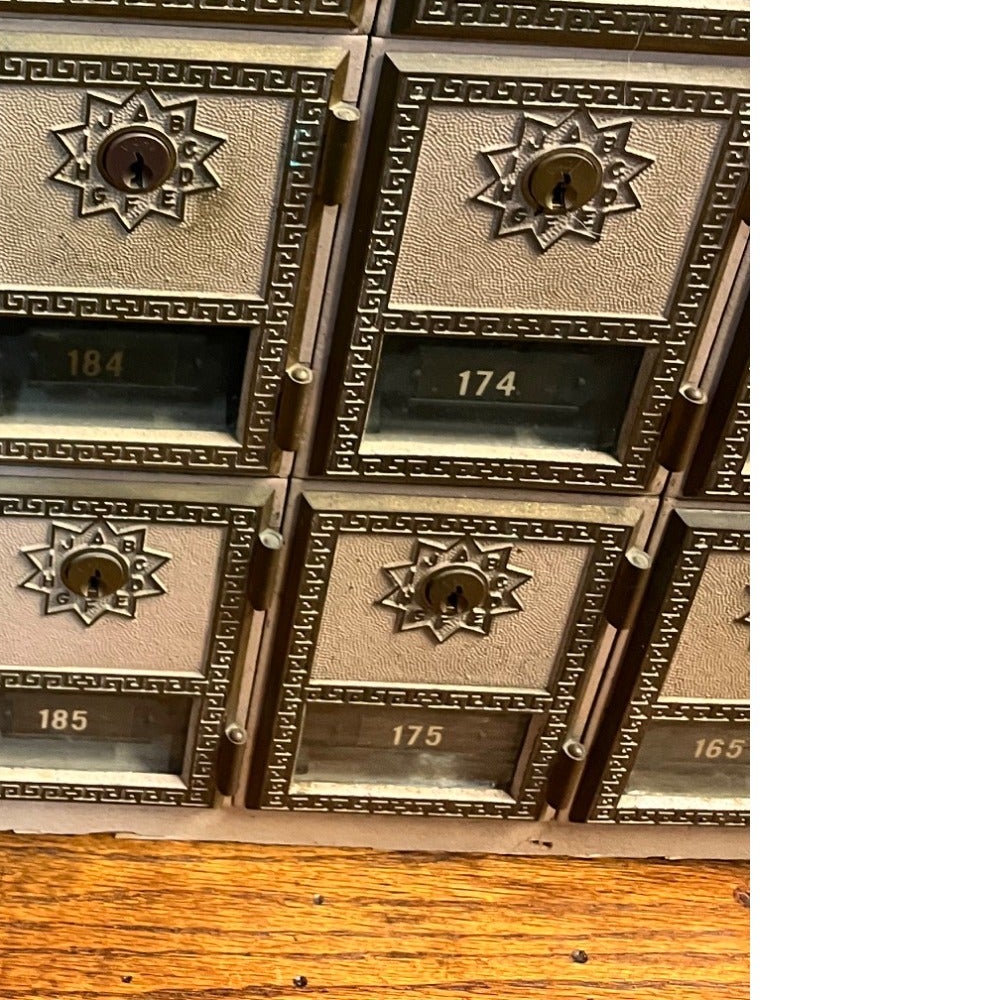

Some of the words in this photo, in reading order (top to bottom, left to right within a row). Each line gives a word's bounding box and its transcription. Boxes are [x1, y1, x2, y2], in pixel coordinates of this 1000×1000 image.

[97, 109, 113, 129] J
[132, 100, 150, 122] A
[170, 112, 185, 134] B
[183, 139, 198, 158] C
[76, 158, 90, 180] H
[180, 164, 194, 185] D
[92, 187, 106, 206] G
[125, 195, 140, 213] F
[162, 185, 176, 206] E
[67, 349, 123, 377] 184
[458, 370, 516, 397] 174
[39, 709, 88, 731] 185
[393, 725, 444, 746] 175
[694, 738, 746, 759] 165
